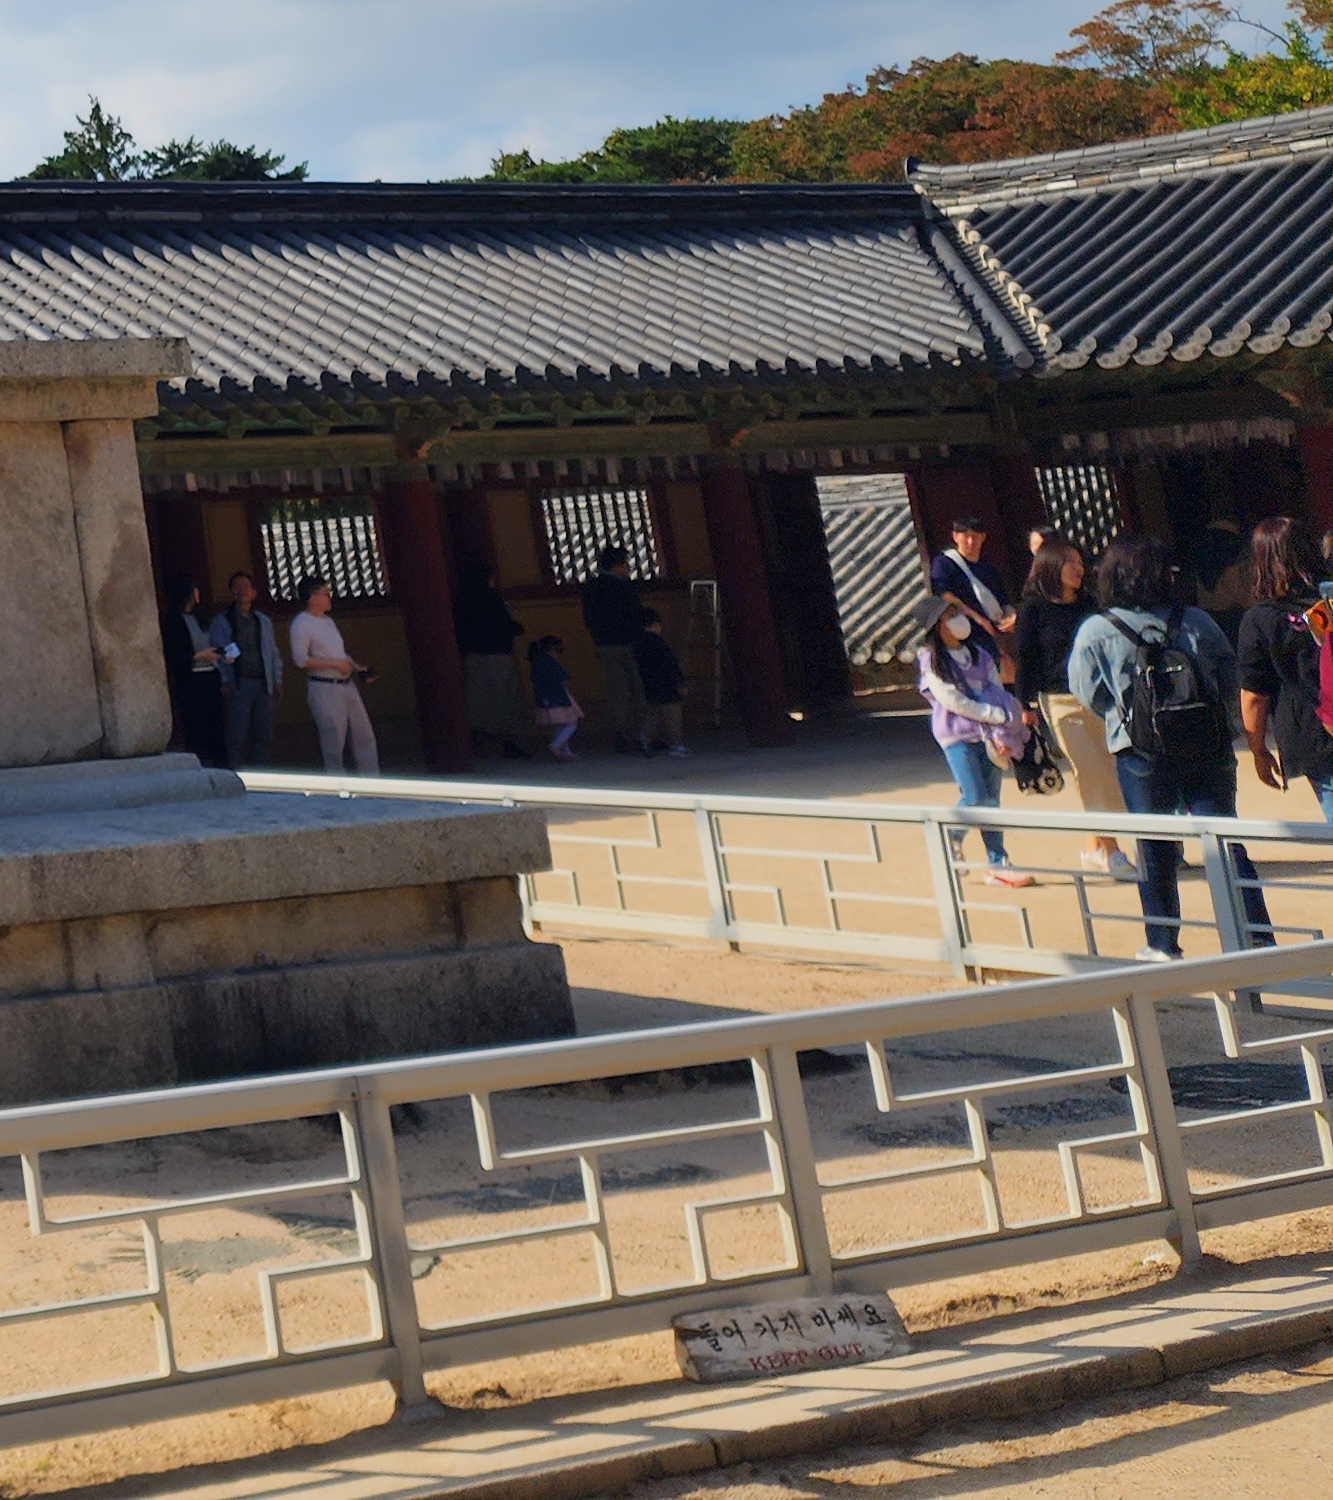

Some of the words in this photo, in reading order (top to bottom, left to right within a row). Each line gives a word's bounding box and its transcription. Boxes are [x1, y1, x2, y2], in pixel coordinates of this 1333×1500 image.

[753, 1309, 805, 1342] 가지
[811, 1303, 888, 1335] 마세요
[748, 1350, 809, 1372] KEEP
[817, 1342, 863, 1362] OUT
